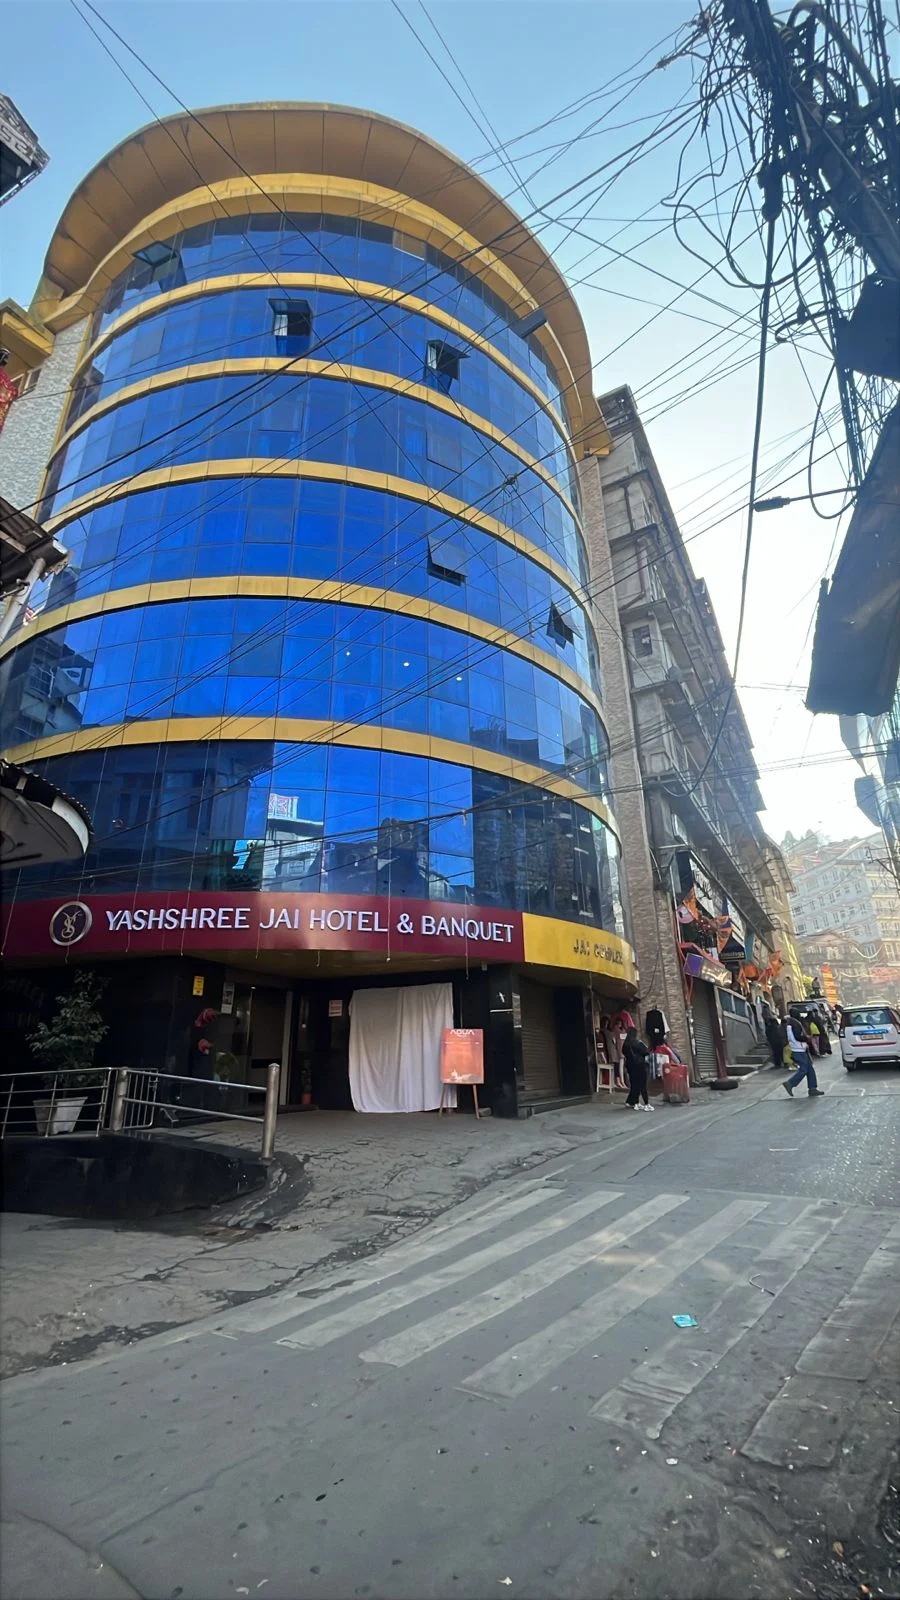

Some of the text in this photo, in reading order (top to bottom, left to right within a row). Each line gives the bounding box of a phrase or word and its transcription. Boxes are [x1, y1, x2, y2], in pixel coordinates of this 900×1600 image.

[105, 907, 515, 943] YASHSHREE JAI HOTEL & BANQUET
